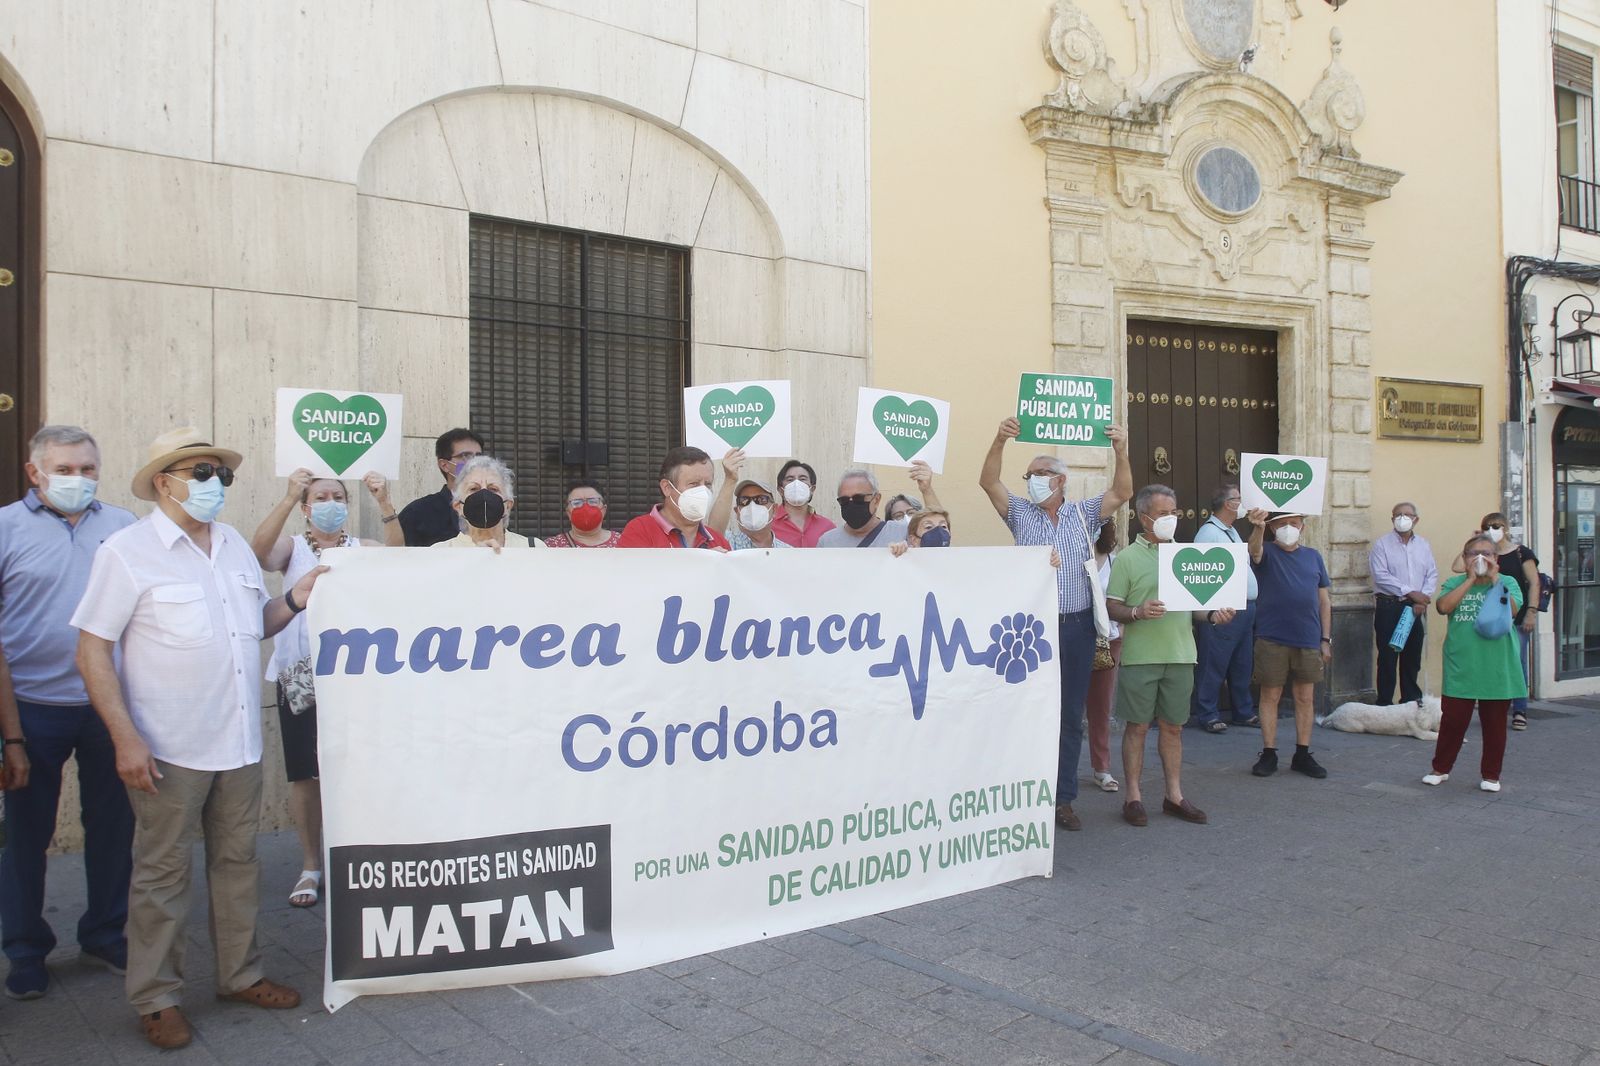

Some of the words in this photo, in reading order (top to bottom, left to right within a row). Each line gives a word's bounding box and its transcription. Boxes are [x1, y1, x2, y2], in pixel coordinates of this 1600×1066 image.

[1222, 236, 1229, 248] 5
[1035, 378, 1098, 402] SANIDAD,
[301, 408, 380, 426] SANIDAD
[711, 402, 764, 416] SANIDAD
[1019, 396, 1078, 419] PÚBLICA
[1081, 402, 1091, 420] Y
[1094, 403, 1111, 421] DE
[713, 415, 762, 429] PÚBLICA
[883, 411, 931, 427] SANIDAD
[308, 426, 374, 444] PÚBLICA
[884, 424, 928, 440] PÚBLICA
[1035, 422, 1094, 442] CALIDAD
[1260, 470, 1304, 480] SANIDAD
[1262, 480, 1300, 491] PÚBLICA
[1181, 562, 1226, 572] SANIDAD
[1183, 573, 1224, 584] PÚBLICA
[315, 622, 627, 677] marea
[656, 594, 886, 665] blanca
[561, 700, 839, 773] Córdoba
[634, 858, 671, 882] POR
[676, 851, 710, 875] UNA
[717, 818, 834, 868] SANIDAD
[842, 798, 943, 846] PÚBLICA,
[348, 861, 386, 890] LOS
[391, 854, 490, 887] RECORTES
[496, 851, 518, 880] EN
[522, 841, 597, 875] SANIDAD
[768, 869, 803, 906] DE
[810, 848, 912, 897] CALIDAD
[918, 843, 932, 873] Y
[938, 821, 1050, 869] UNIVERSAL
[361, 886, 585, 959] MATAN
